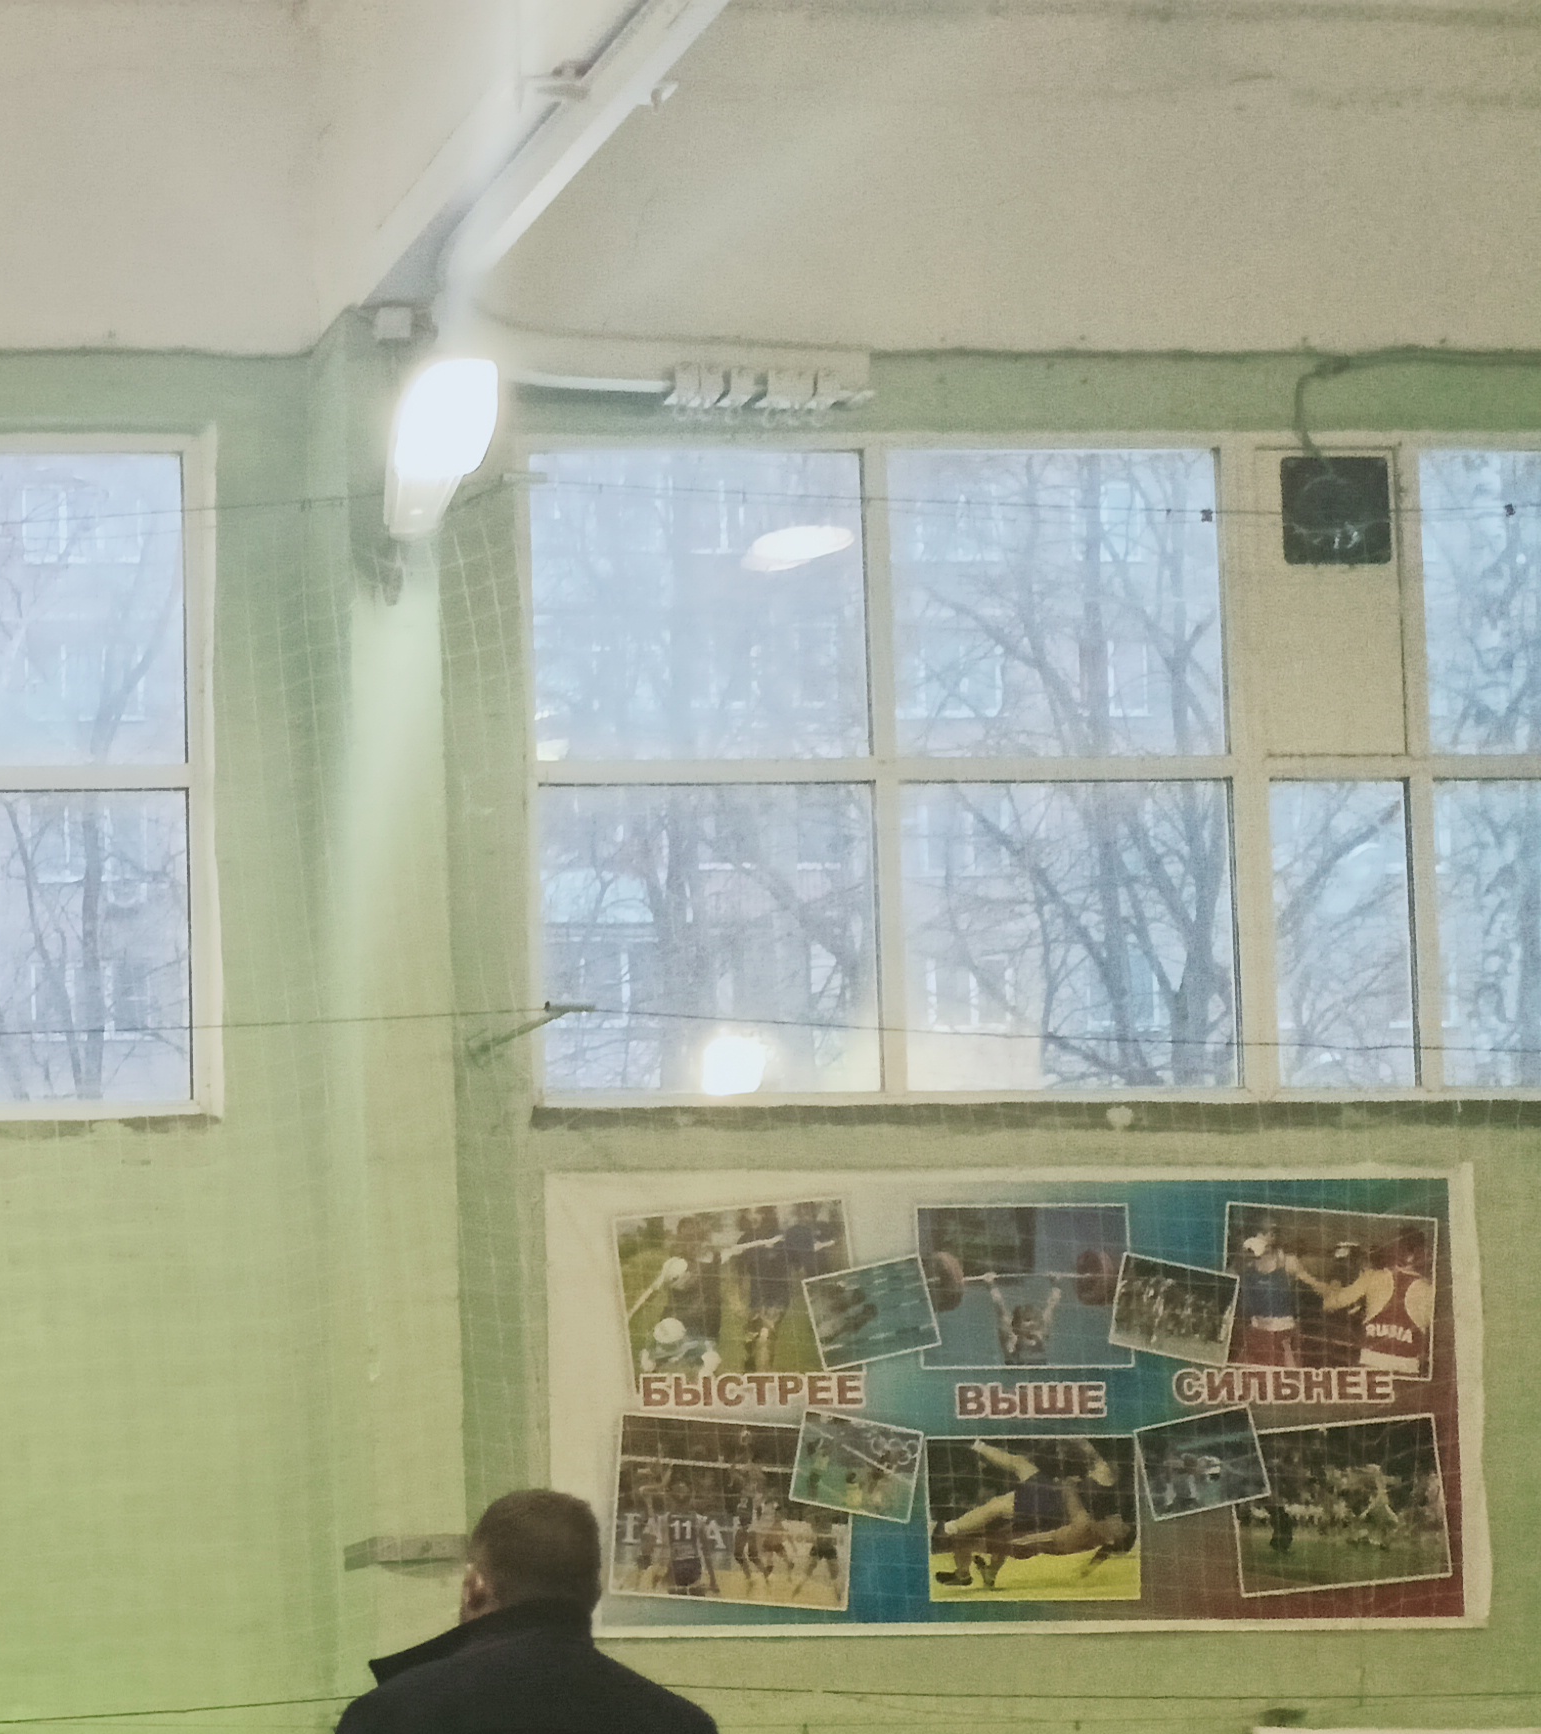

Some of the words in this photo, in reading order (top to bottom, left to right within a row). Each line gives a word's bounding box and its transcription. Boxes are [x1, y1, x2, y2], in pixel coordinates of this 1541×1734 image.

[639, 1373, 866, 1408] БЫСТРЕЕ
[956, 1381, 1107, 1419] ВЫШЕ
[1173, 1368, 1394, 1405] СИЛЬНЕЕ
